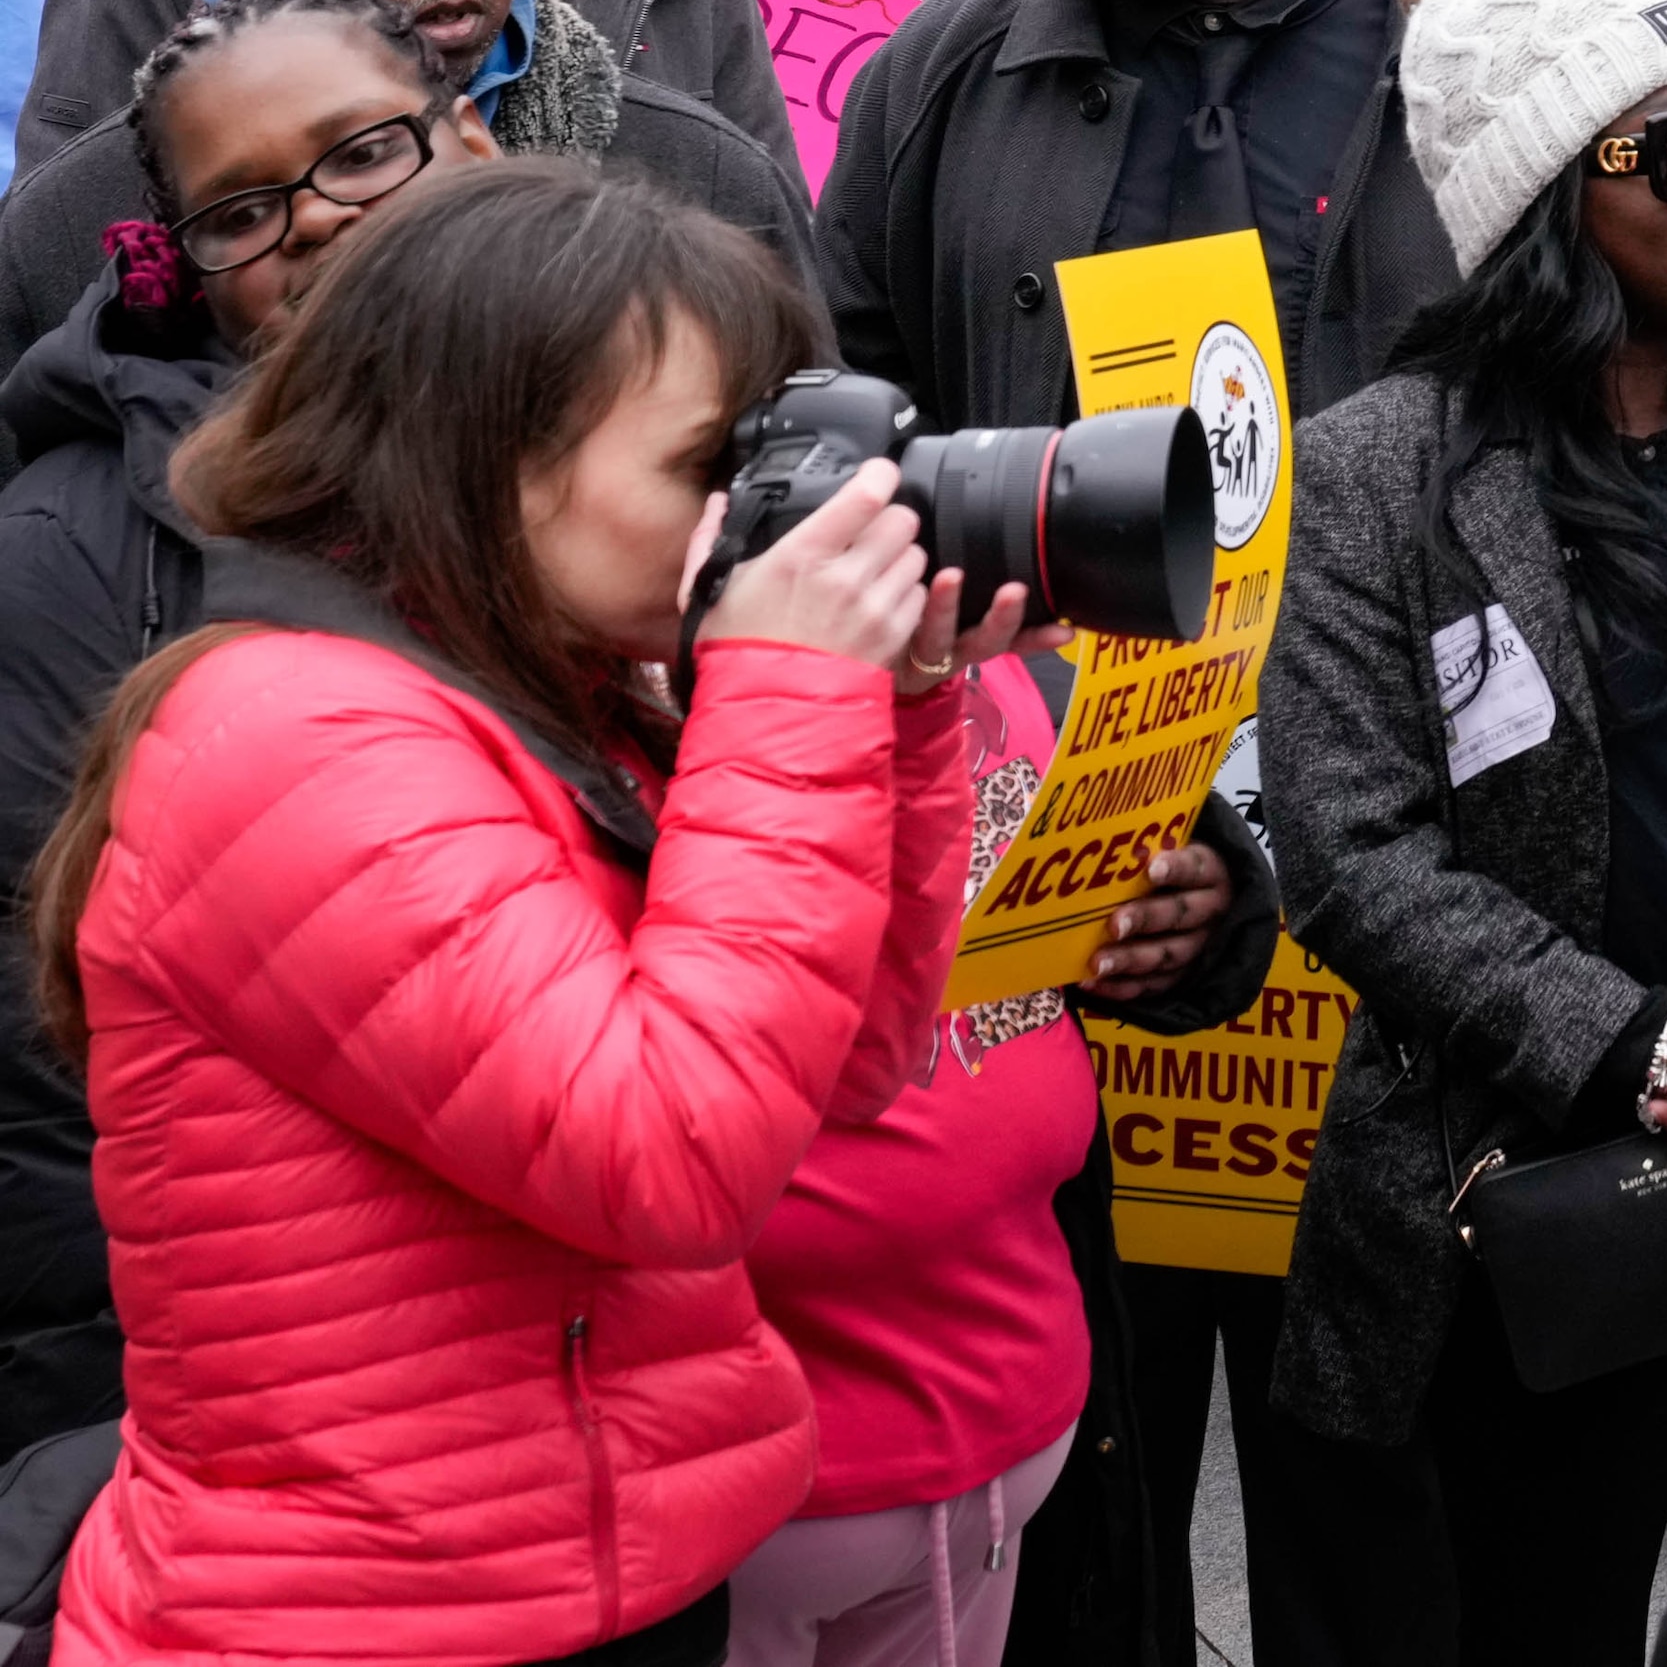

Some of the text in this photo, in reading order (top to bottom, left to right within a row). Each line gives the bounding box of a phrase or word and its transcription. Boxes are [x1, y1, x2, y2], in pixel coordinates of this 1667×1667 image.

[1233, 568, 1269, 631] OUR
[1067, 645, 1256, 758] LIFE, LIBERTY,
[1029, 727, 1229, 840] & COMMUNITY
[983, 805, 1198, 916] ACCESS!
[1086, 1040, 1337, 1111] OMMUNIT
[1112, 1112, 1320, 1182] CESS
